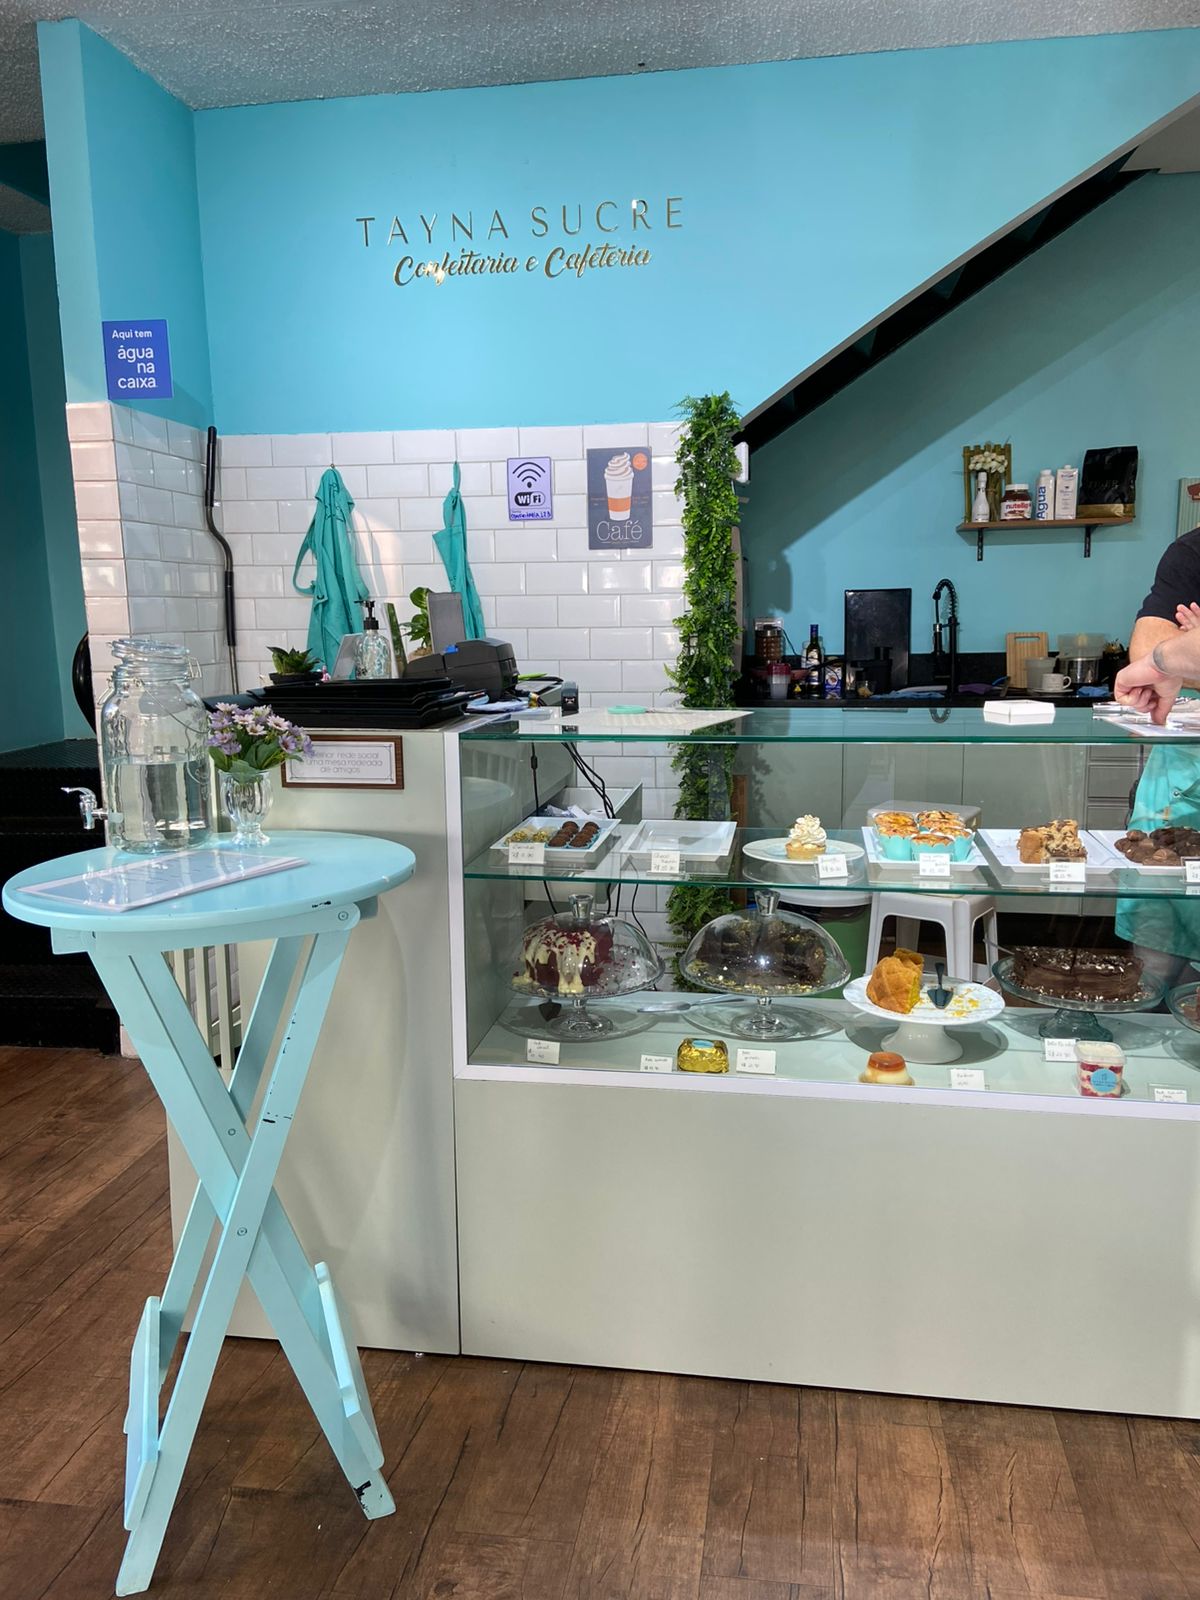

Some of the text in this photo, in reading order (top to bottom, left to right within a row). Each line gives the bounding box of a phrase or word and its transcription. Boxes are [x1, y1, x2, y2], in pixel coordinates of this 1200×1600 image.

[355, 197, 683, 247] TAYNA SUCRE
[393, 242, 652, 287] Confeitaria e Cafeteria
[112, 329, 152, 340] Aqui tem
[117, 345, 154, 363] água
[137, 362, 155, 374] na
[117, 377, 157, 389] caixa
[596, 519, 643, 541] Café
